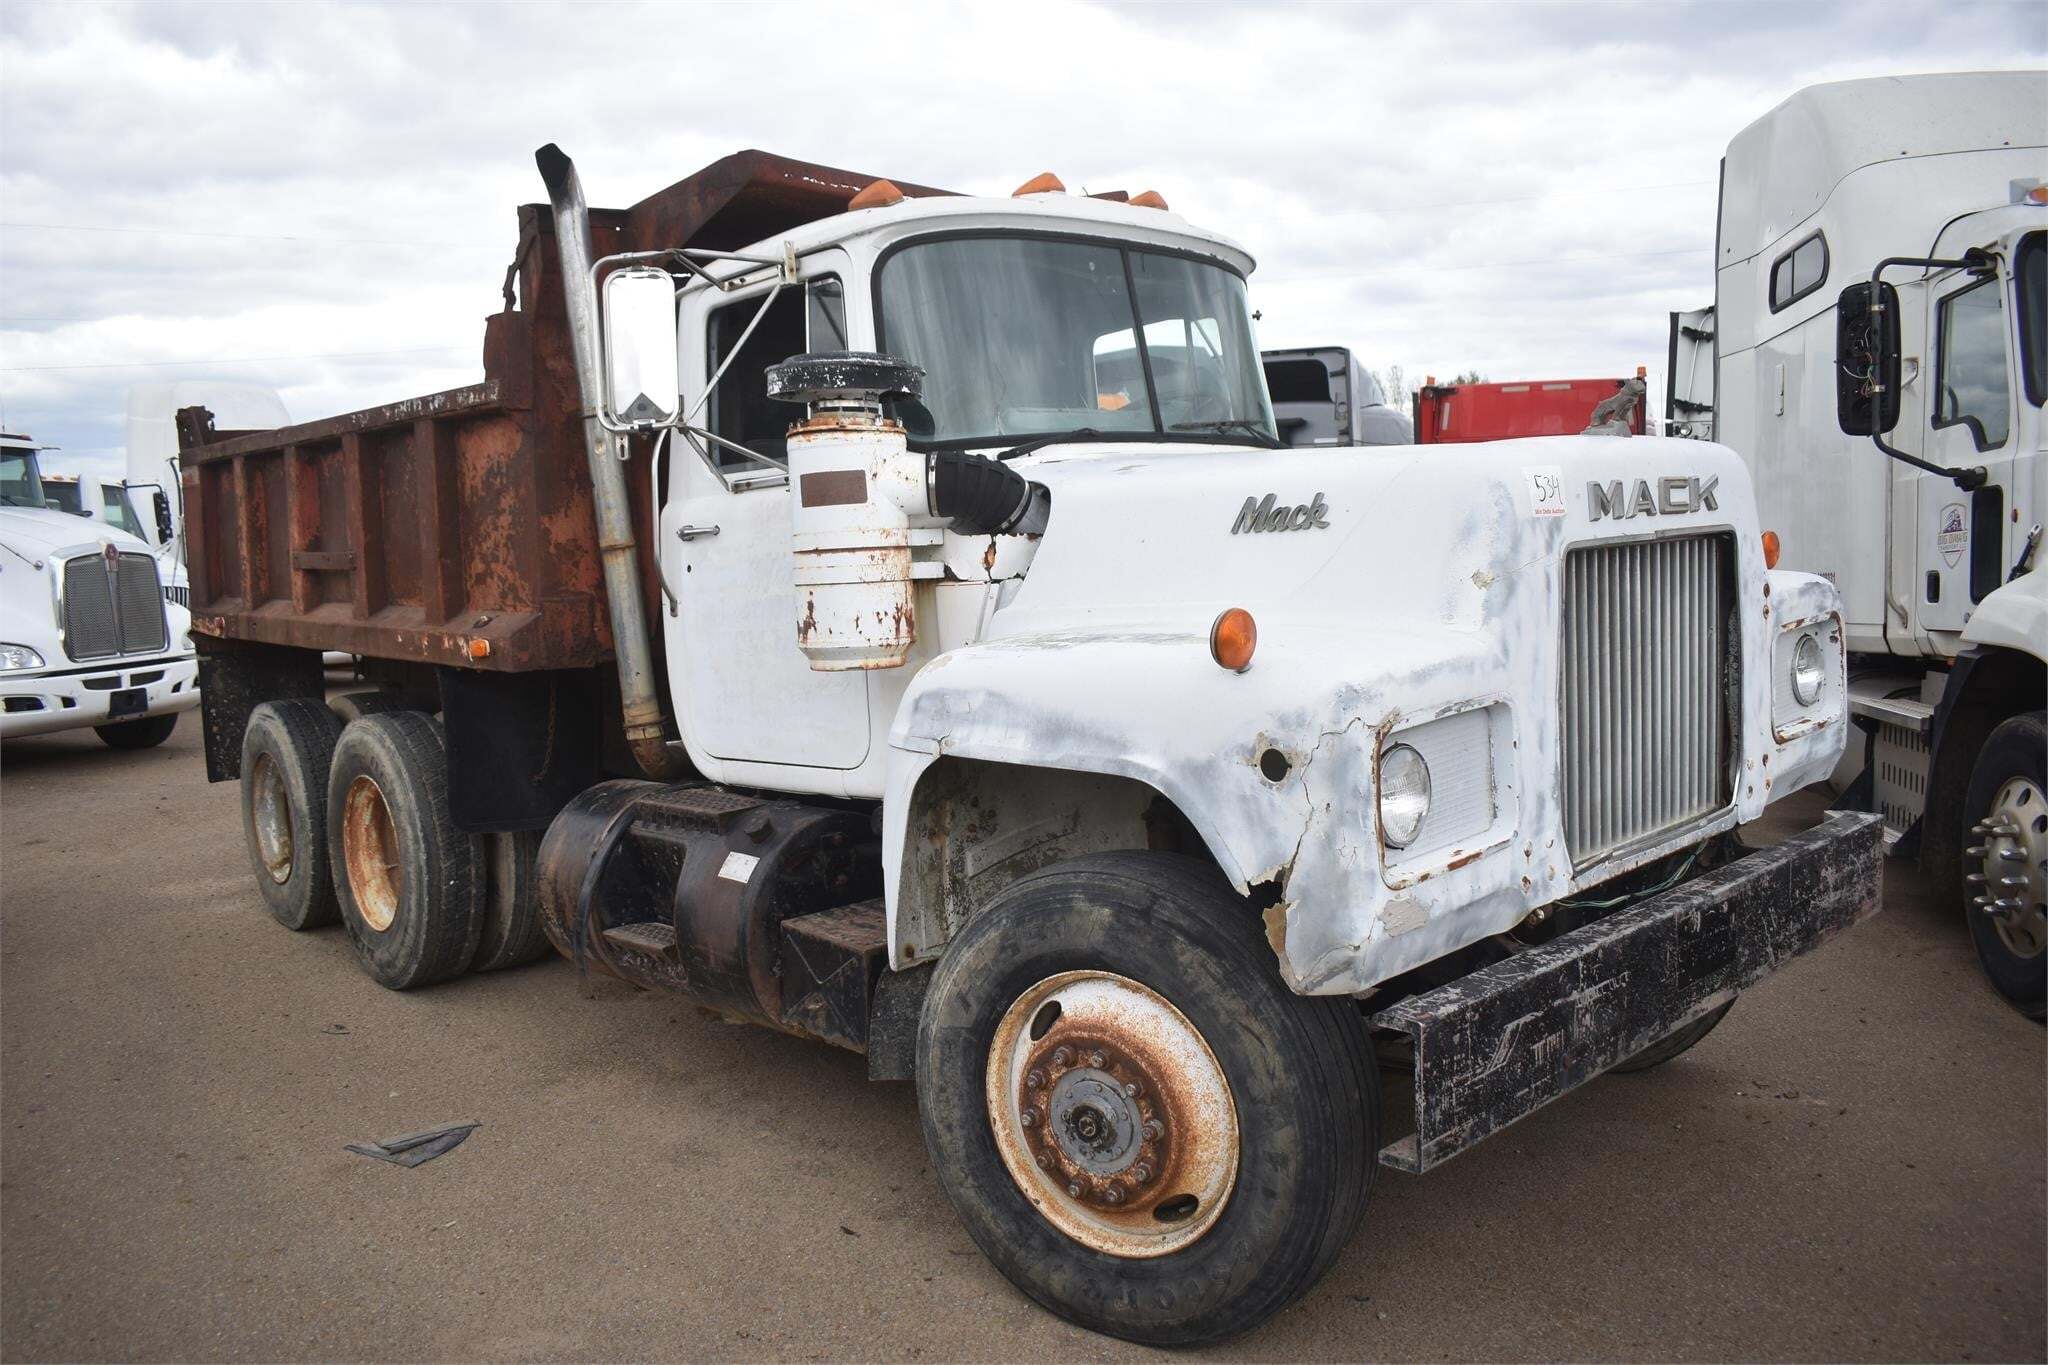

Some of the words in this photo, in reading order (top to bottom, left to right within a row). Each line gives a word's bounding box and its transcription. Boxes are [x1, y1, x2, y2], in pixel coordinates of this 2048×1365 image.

[1534, 474, 1563, 505] 534
[1587, 473, 1718, 522] MACK
[1231, 492, 1331, 535] Mack
